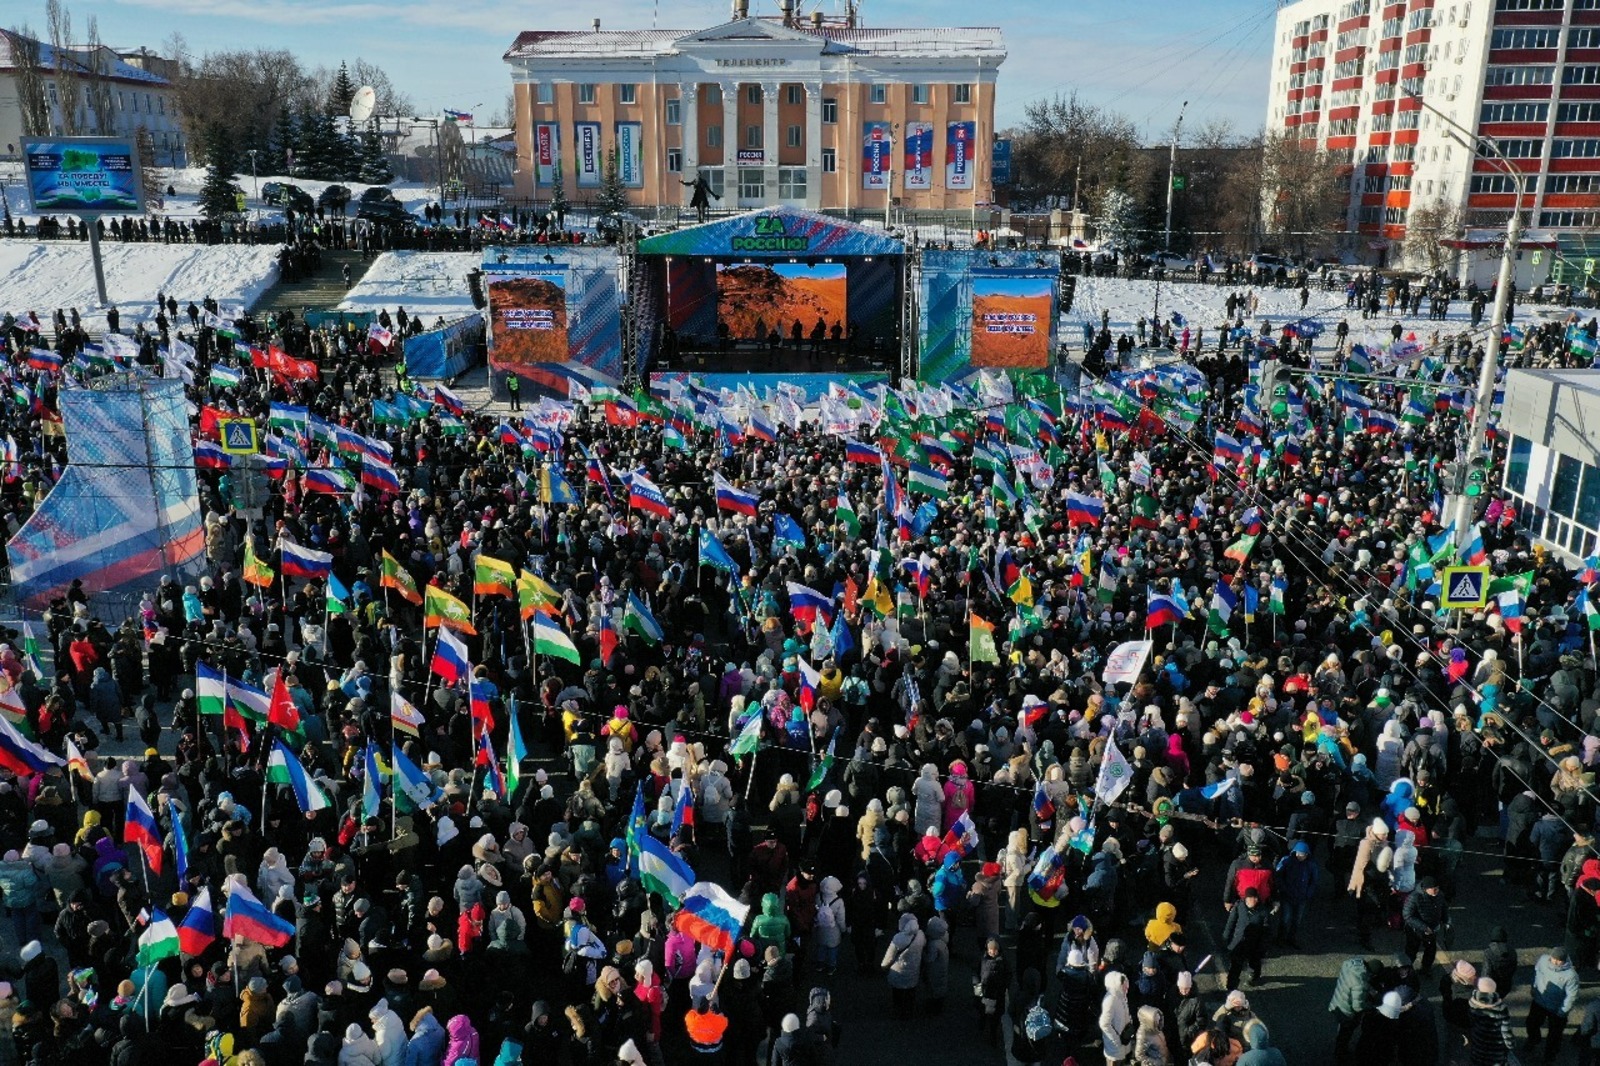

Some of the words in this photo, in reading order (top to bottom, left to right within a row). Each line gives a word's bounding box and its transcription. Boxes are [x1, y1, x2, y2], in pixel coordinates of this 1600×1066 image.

[714, 58, 786, 67] ТЕЛЕЦЕНТР
[541, 132, 550, 160] МАЯК
[756, 217, 785, 234] ZA
[733, 237, 807, 250] РОССИЮ!
